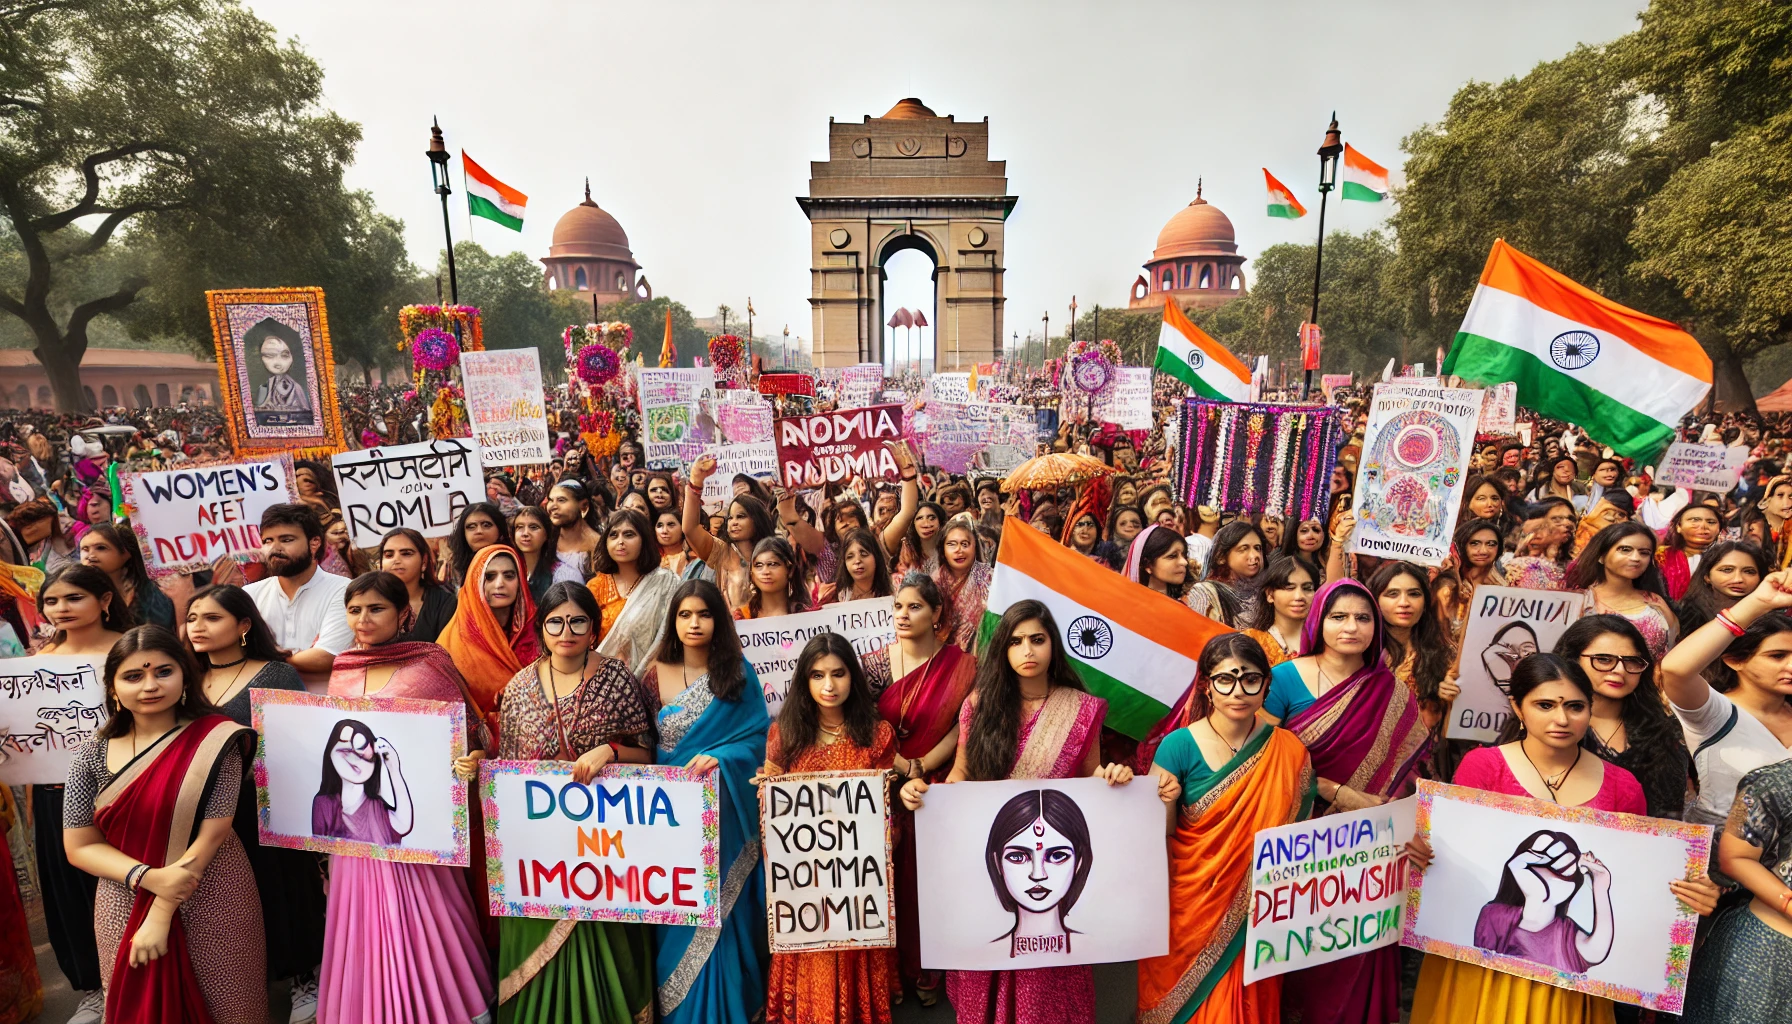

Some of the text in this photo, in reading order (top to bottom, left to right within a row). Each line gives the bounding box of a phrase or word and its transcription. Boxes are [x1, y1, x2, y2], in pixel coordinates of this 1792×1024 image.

[142, 464, 279, 504] WOMEN'S
[525, 780, 680, 827] DOMIA
[771, 779, 877, 819] DAMA
[771, 819, 859, 853] YOSM
